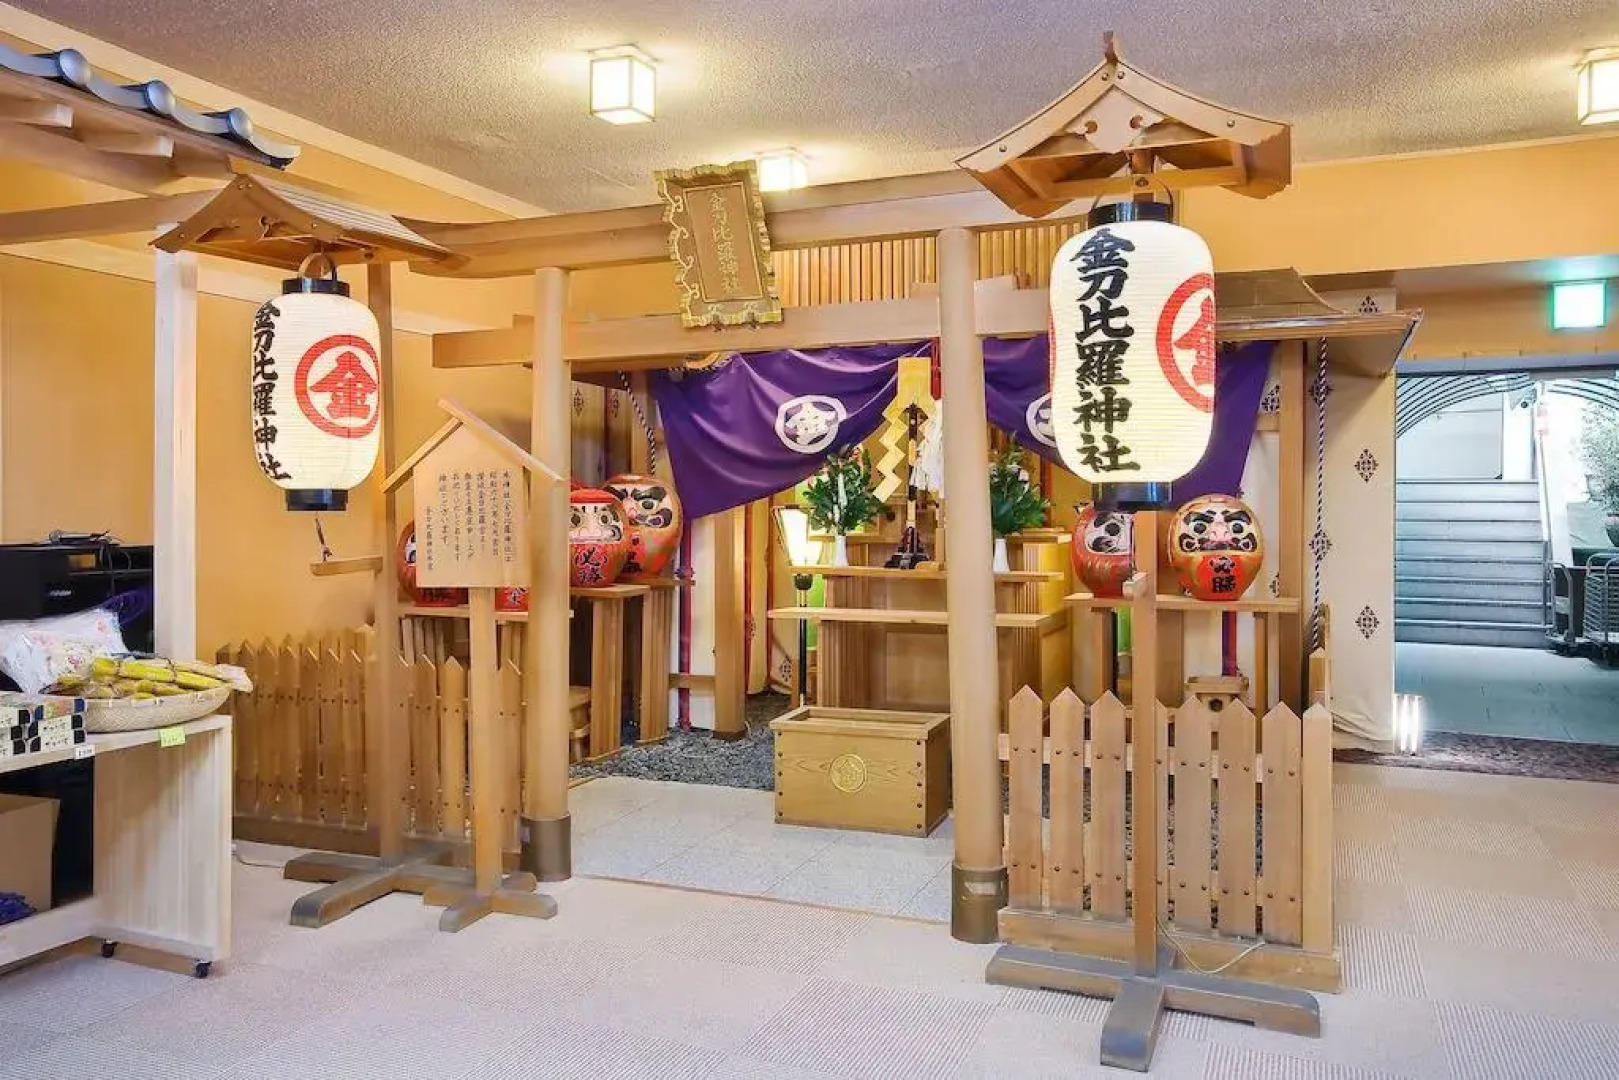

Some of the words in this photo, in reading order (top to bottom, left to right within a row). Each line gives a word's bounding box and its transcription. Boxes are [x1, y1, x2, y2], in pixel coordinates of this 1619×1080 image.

[252, 300, 292, 480] 金刀比羅神社
[306, 346, 378, 424] 金
[1069, 227, 1141, 473] 金刀比羅神社
[1209, 556, 1236, 594] 必勝
